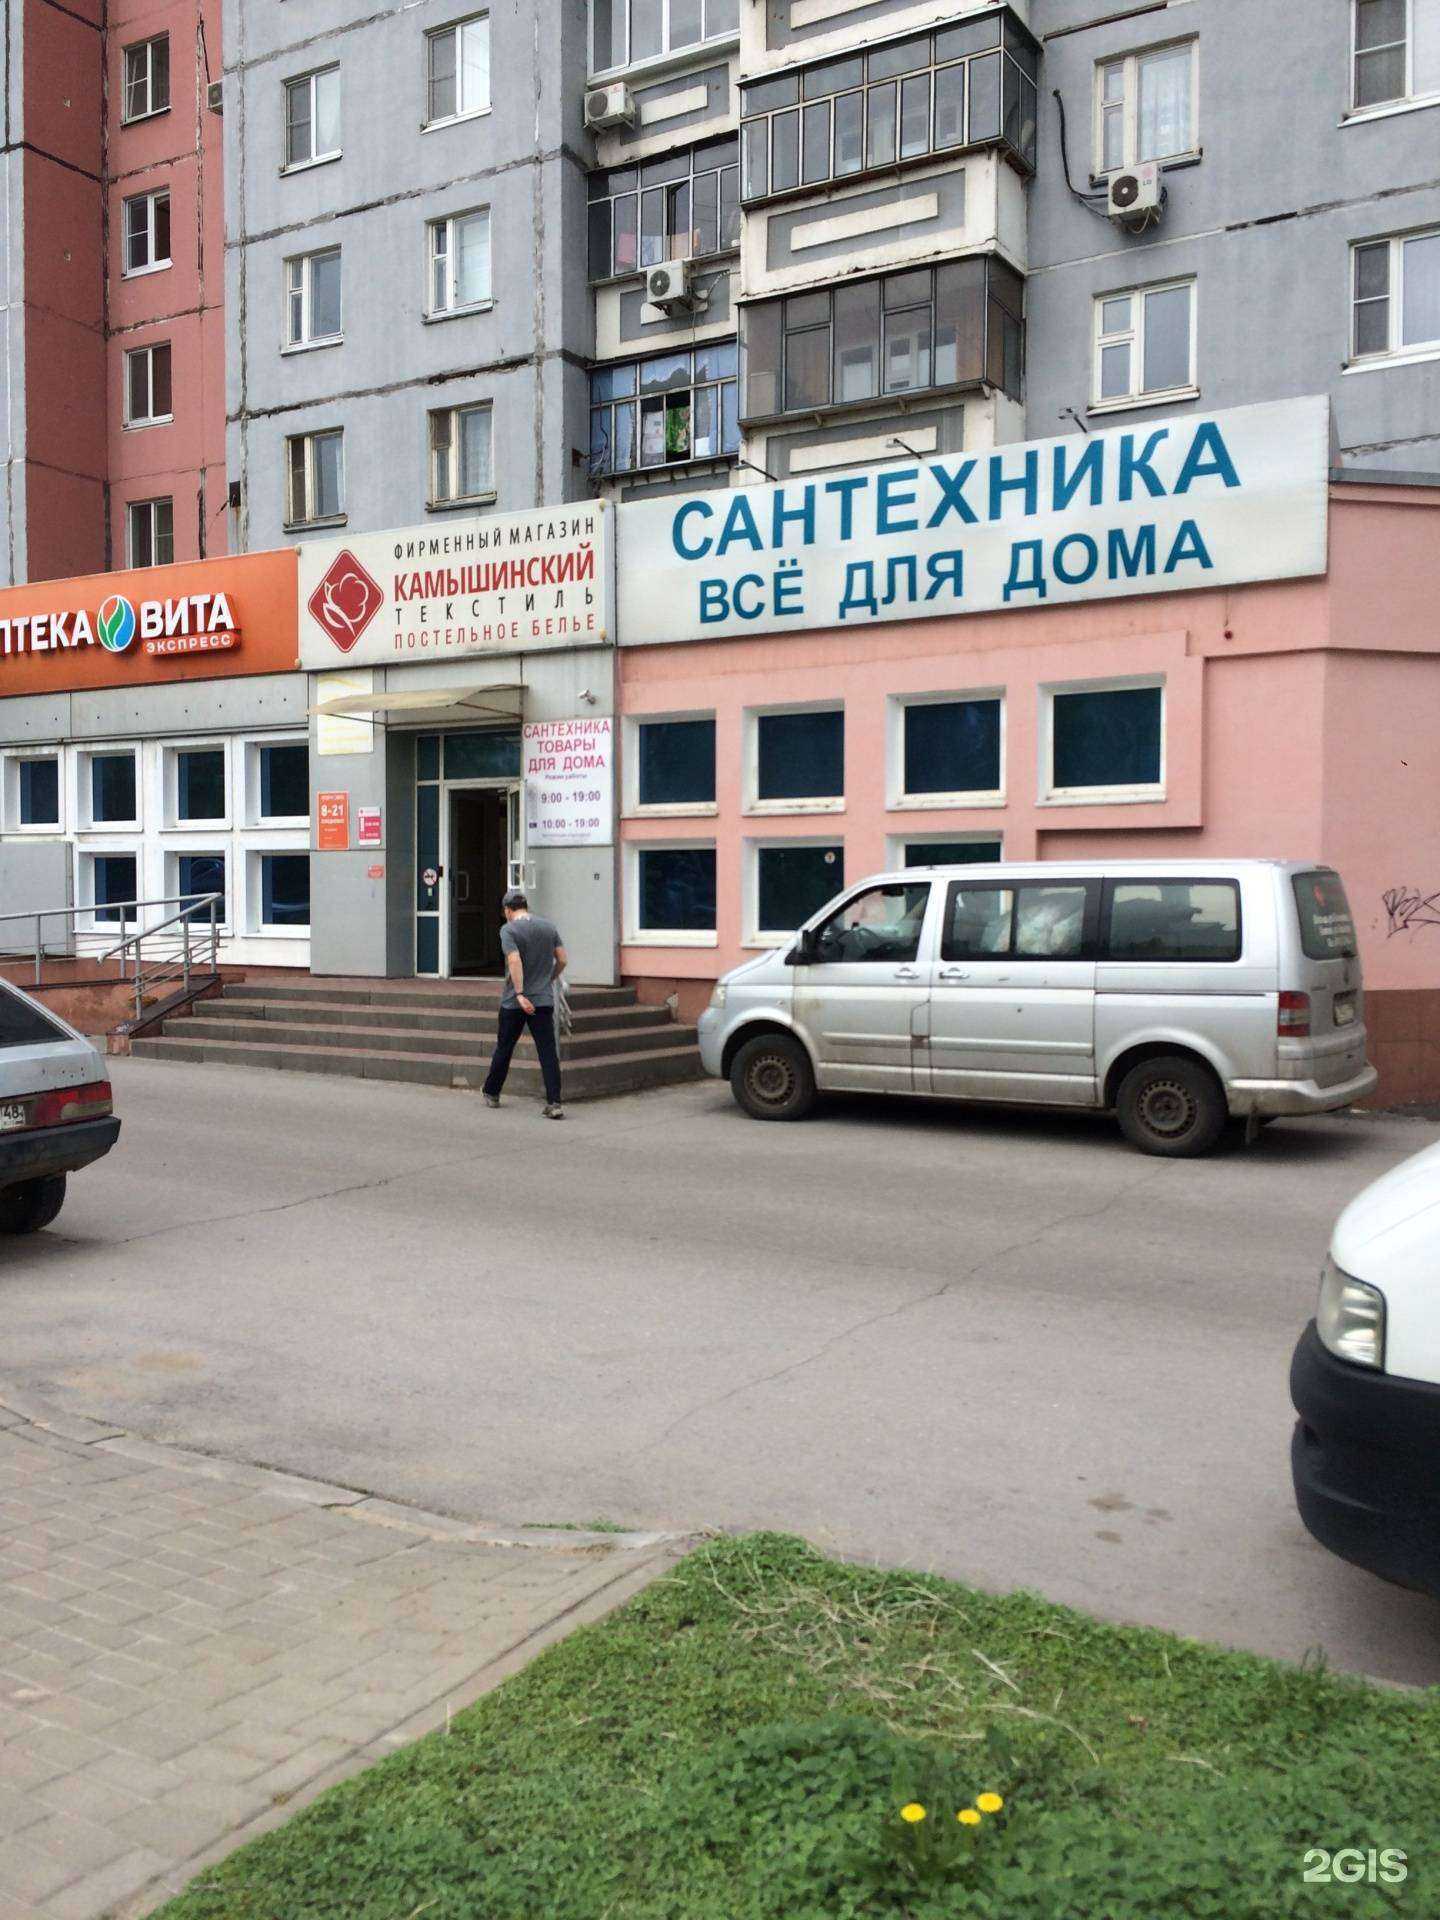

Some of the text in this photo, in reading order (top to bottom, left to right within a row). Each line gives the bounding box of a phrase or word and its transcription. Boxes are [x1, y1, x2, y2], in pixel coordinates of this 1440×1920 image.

[672, 421, 1241, 561] САНТЕХНИКА
[394, 516, 594, 560] ФИРМЕННЫЙ МАГАЗИН
[394, 541, 594, 602] КАМЫШИНСКИЙ
[699, 518, 1213, 624] ВСЁ ДЛЯ ДОМА
[140, 592, 235, 639] ВИТА
[395, 587, 594, 626] ТЕКСТИЛЬ
[146, 634, 231, 654] ЭКСПРЕСС
[395, 613, 595, 650] ПОСТЕЛЬНОЕ БЕЛЬЕ
[523, 720, 611, 739] САНТЕХНИКА
[537, 738, 596, 754] ТОВАРЫ
[528, 755, 606, 774] ДЛЯ ДОМА
[541, 792, 562, 804] 9:00
[573, 790, 601, 803] 19:00
[575, 817, 600, 829] 19:00
[4, 1104, 18, 1119] 48
